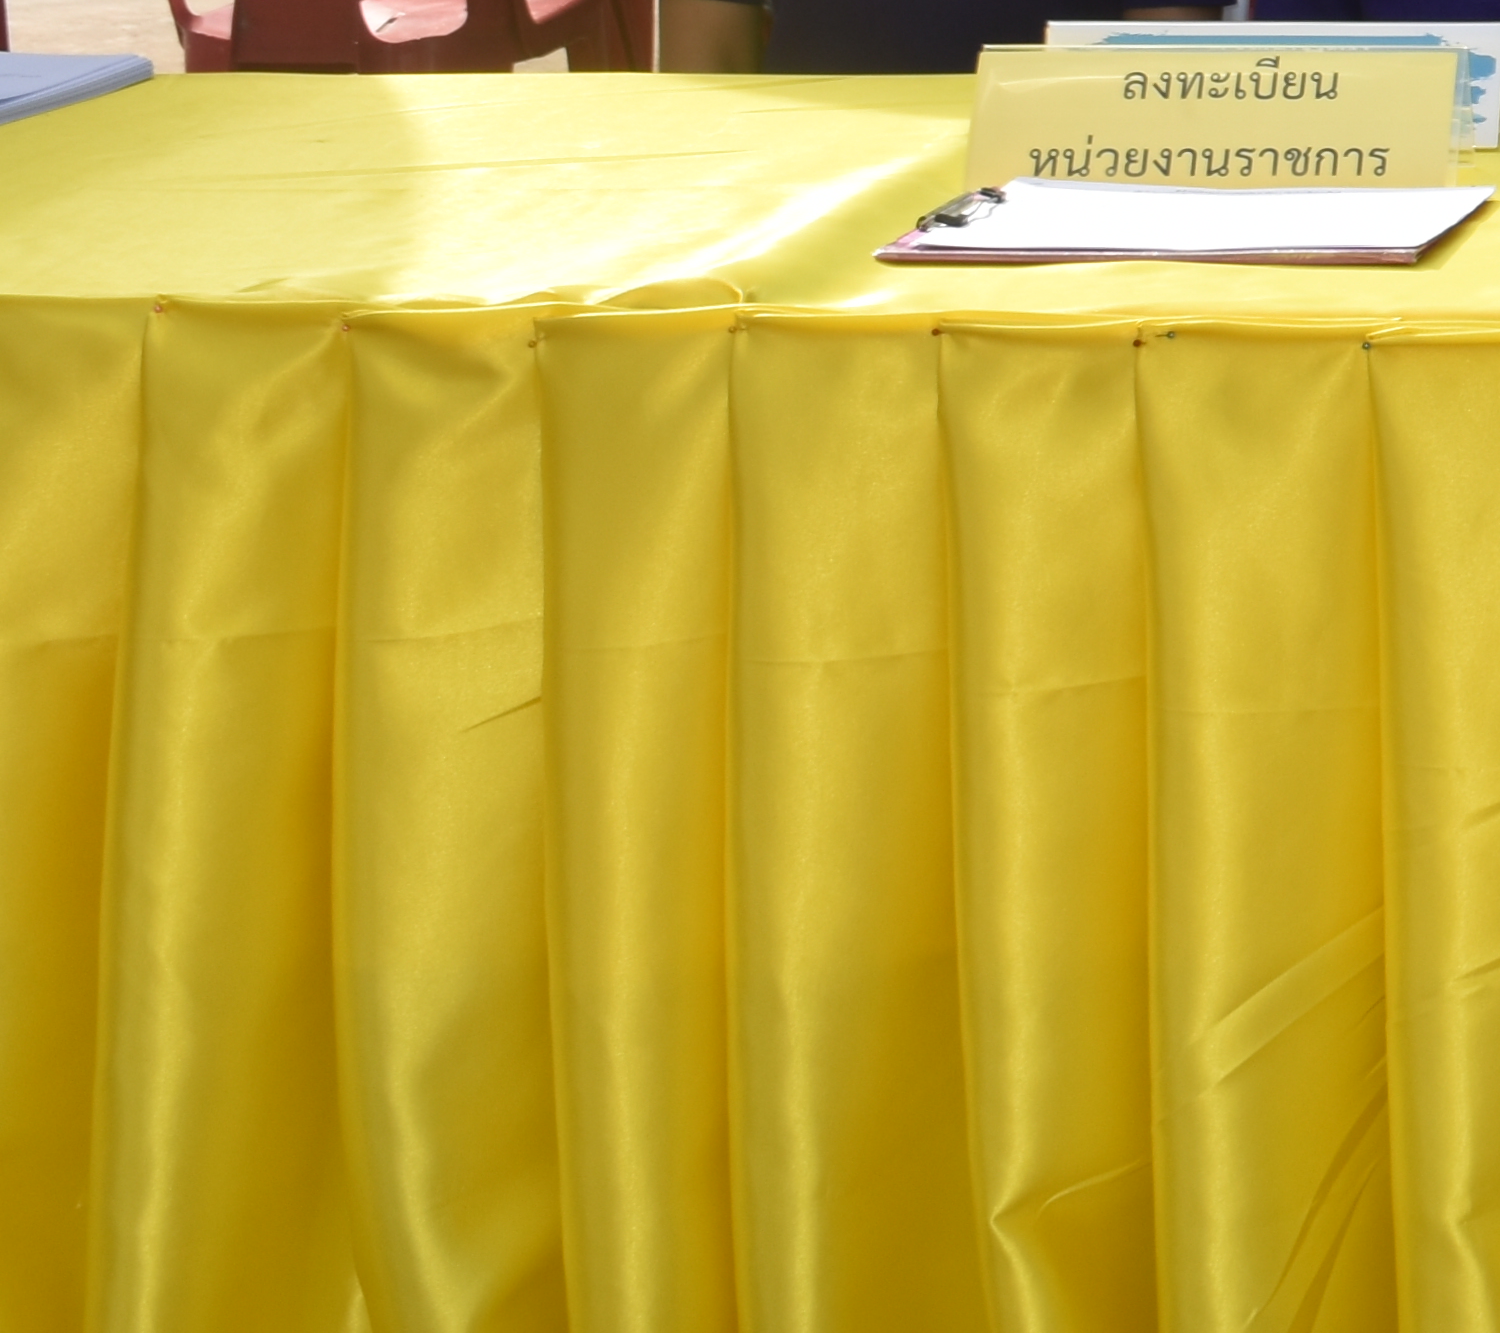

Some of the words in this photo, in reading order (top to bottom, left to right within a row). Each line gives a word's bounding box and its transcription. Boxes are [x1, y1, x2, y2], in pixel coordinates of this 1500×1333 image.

[1122, 55, 1339, 100] ลงทะเบียน
[1029, 135, 1390, 177] หน่วยงานราชการ
